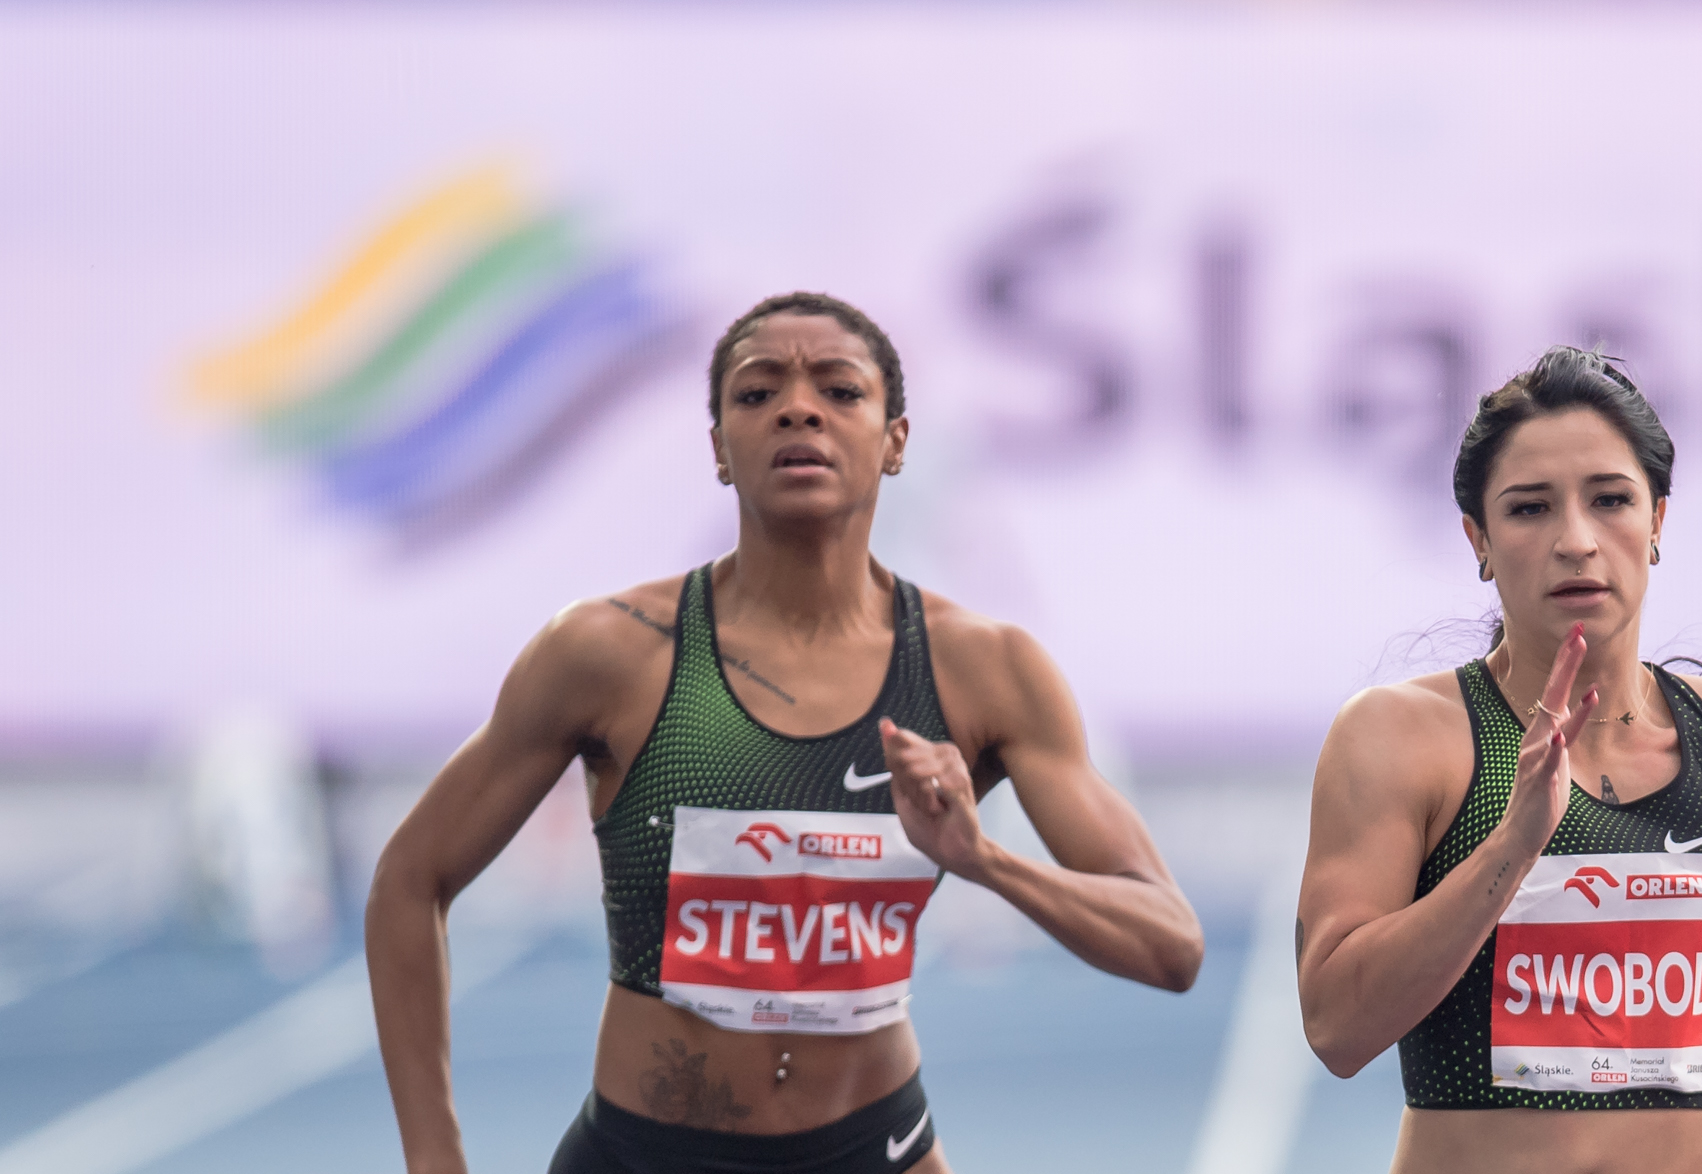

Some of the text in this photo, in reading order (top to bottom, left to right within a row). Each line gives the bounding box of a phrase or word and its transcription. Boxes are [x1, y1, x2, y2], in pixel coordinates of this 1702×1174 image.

[801, 834, 878, 857] ORLEN
[675, 899, 915, 966] STEVENS
[1630, 1066, 1659, 1074] Janusza
[1593, 1074, 1627, 1082] ORLEN
